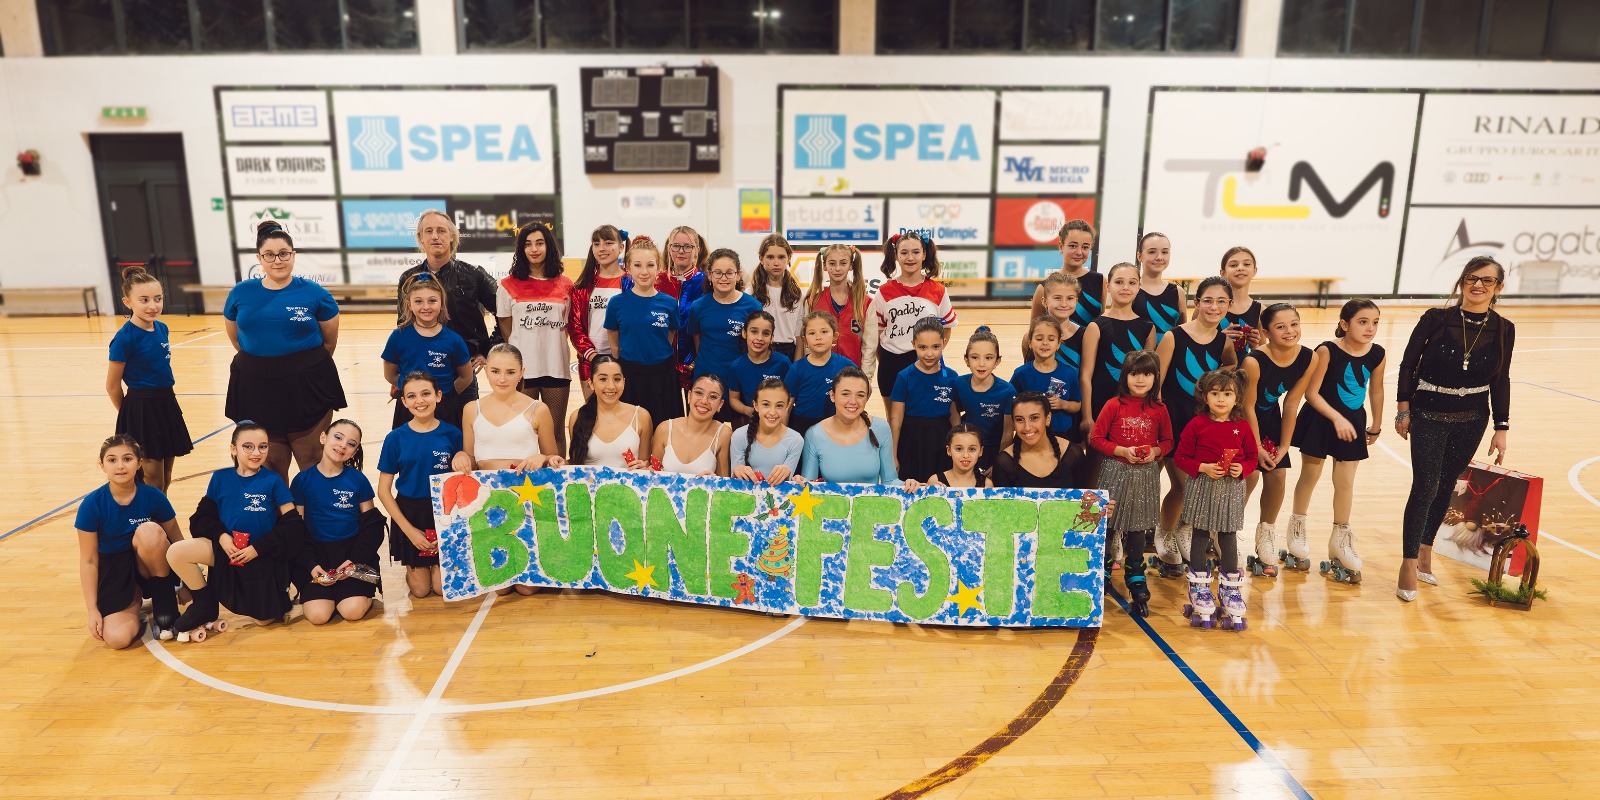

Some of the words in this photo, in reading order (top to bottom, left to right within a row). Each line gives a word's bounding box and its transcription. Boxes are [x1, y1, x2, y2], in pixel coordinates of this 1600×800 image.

[407, 124, 541, 162] SPEA
[852, 123, 980, 161] SPEA
[235, 157, 271, 172] DARK
[275, 157, 326, 172] COMICS
[1049, 166, 1089, 174] MICRO
[1049, 175, 1083, 183] MEGA
[787, 207, 858, 222] studio
[938, 227, 977, 240] Olimpic
[1513, 226, 1600, 261] agat
[589, 295, 608, 304] addys
[520, 316, 533, 330] Lil
[469, 483, 757, 599] BUONE
[794, 492, 1094, 620] FESTE
